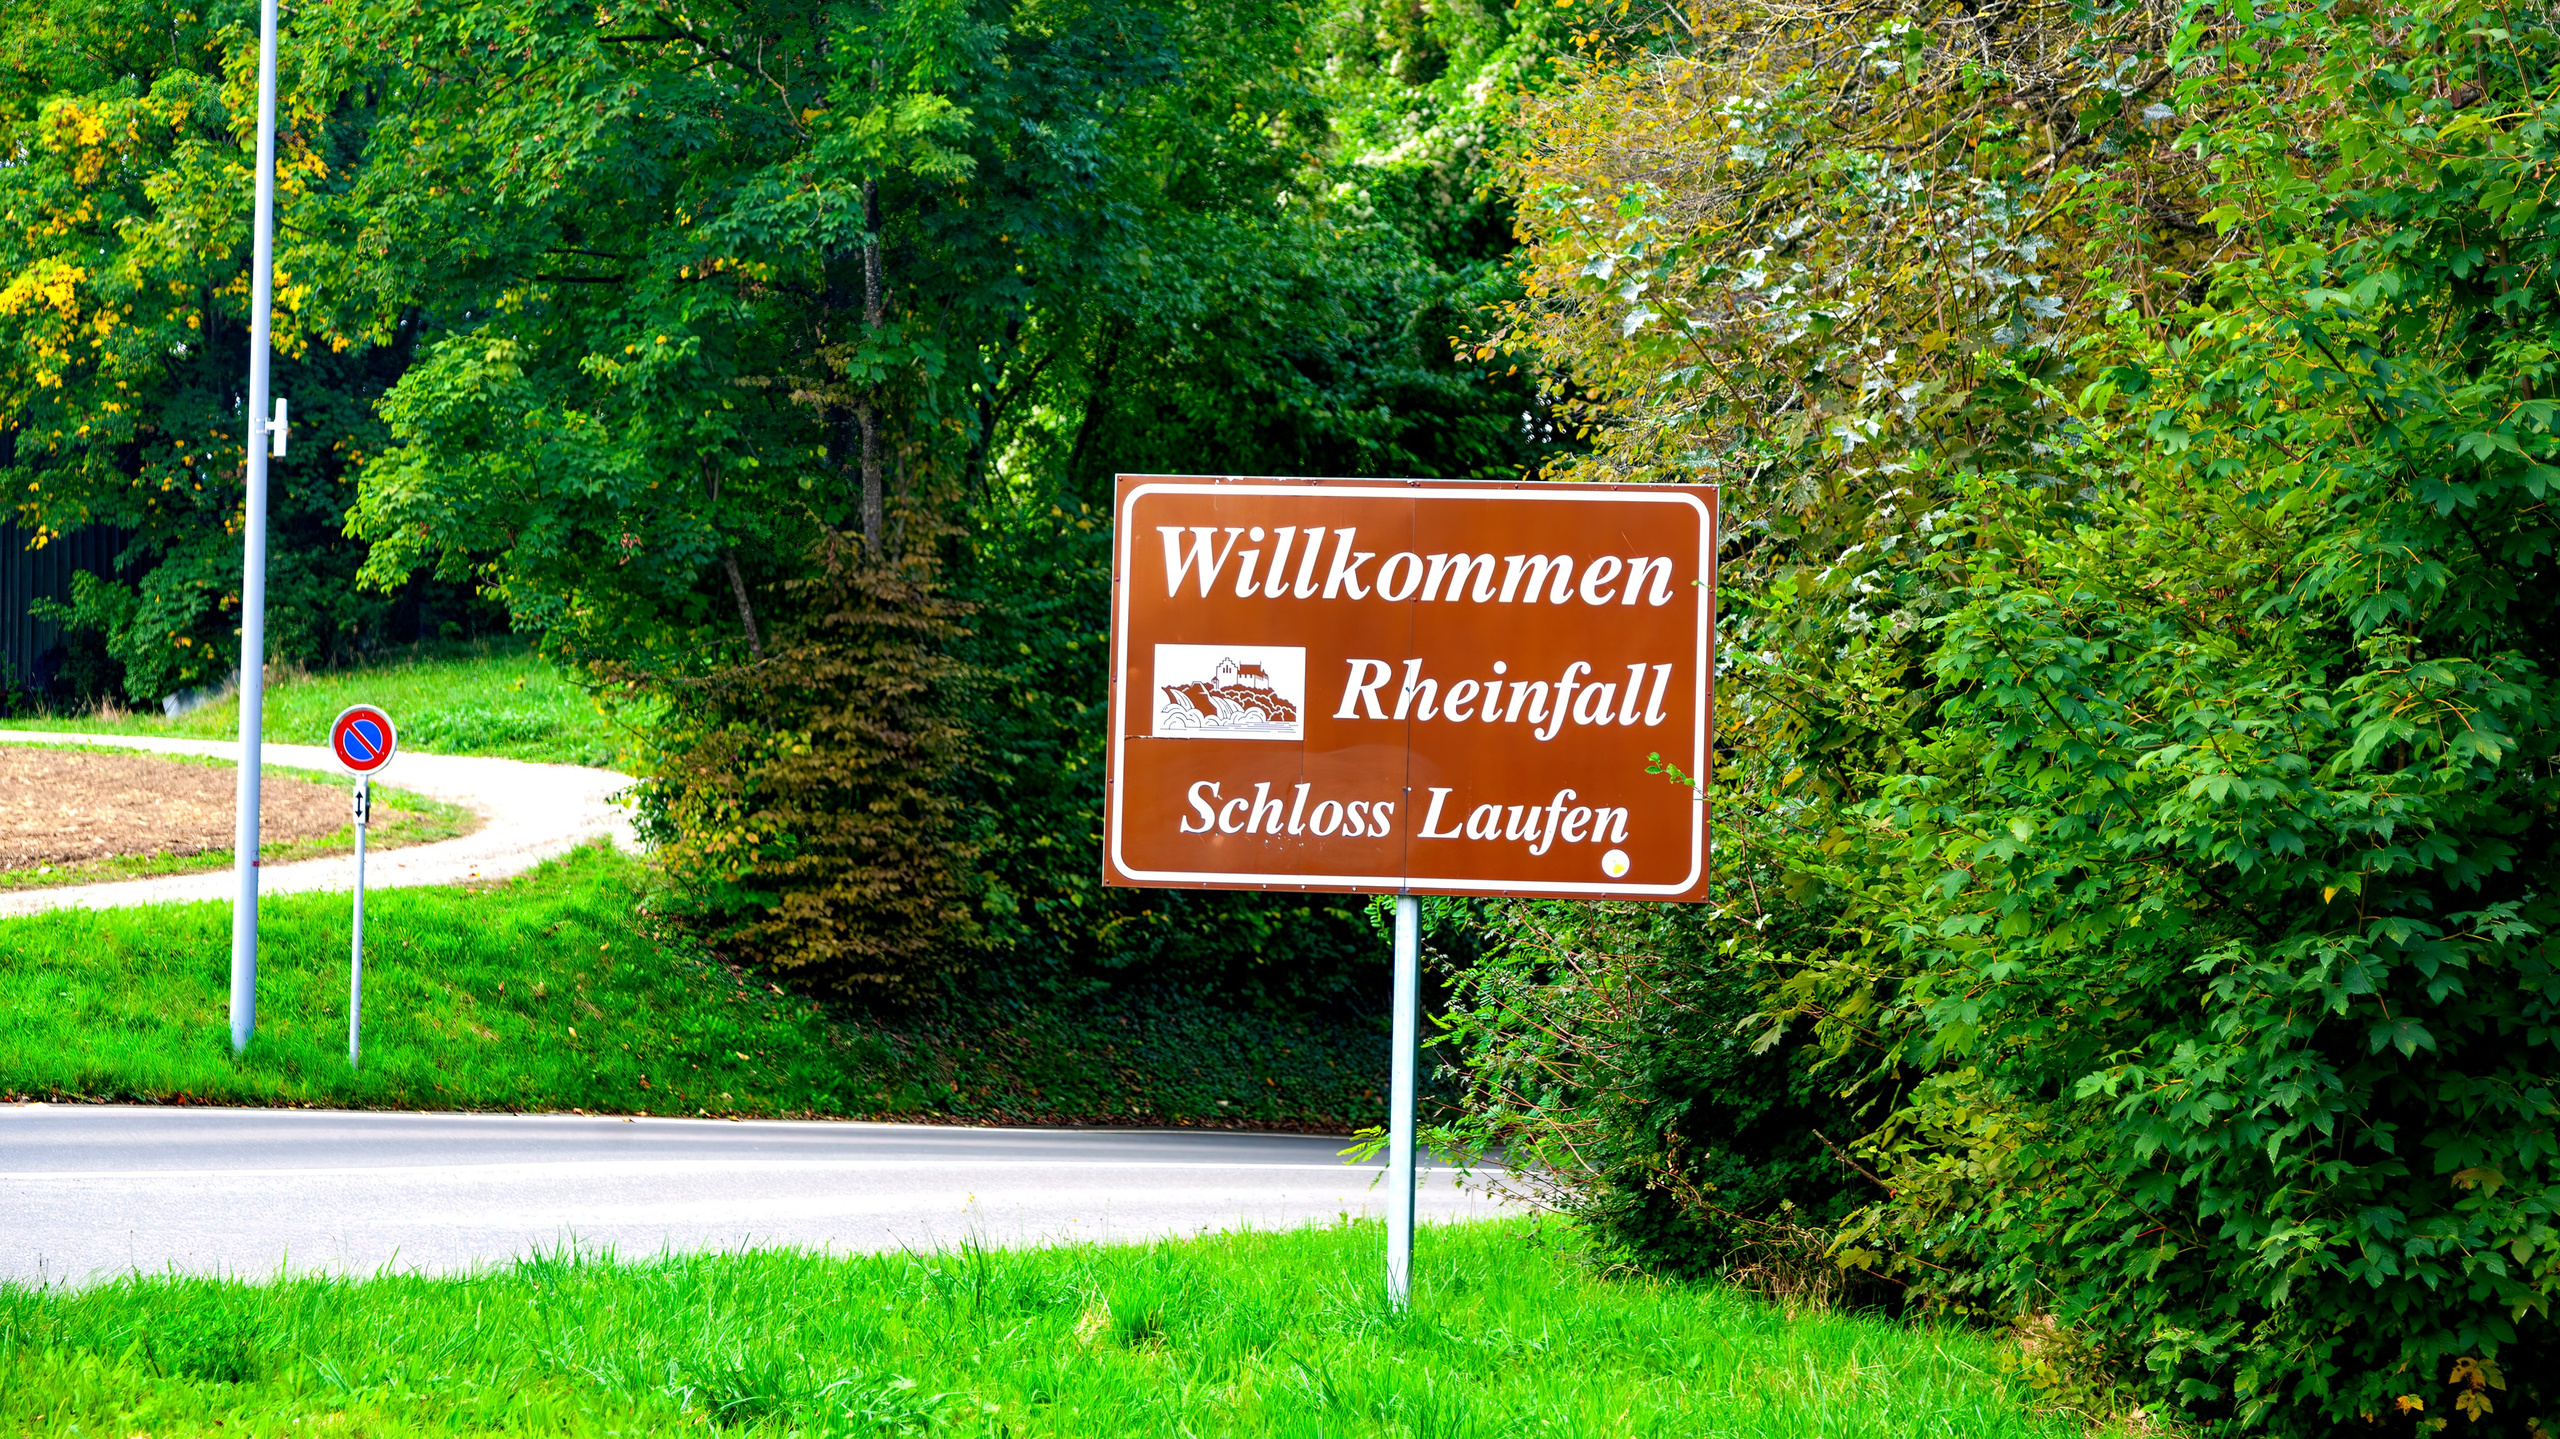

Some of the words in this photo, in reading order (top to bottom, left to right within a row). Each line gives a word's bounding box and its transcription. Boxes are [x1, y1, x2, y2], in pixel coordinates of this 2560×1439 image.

[1155, 525, 1674, 606] Willkommen
[1332, 658, 1673, 742] Rheinfall
[1179, 780, 1395, 838] Schloss
[1416, 787, 1629, 856] Laufen
